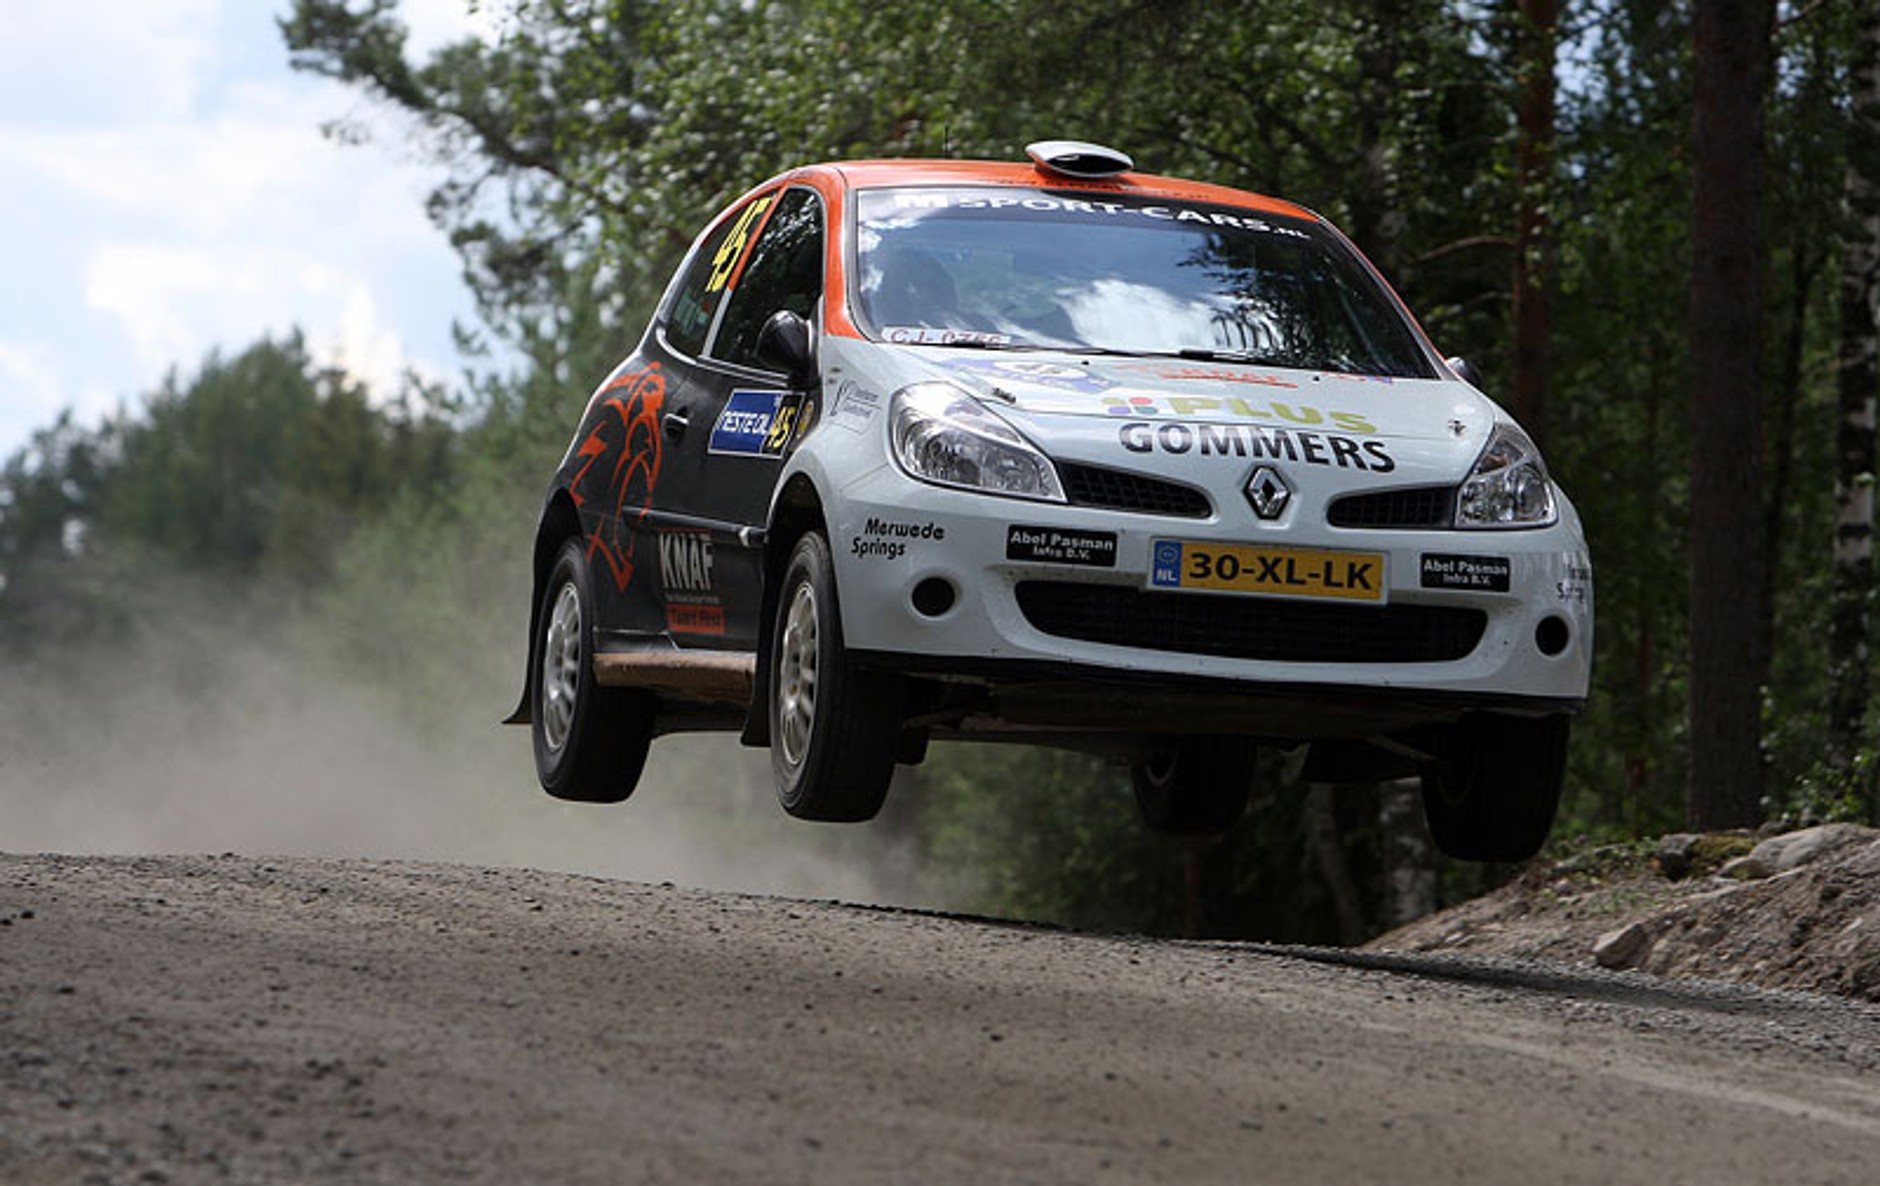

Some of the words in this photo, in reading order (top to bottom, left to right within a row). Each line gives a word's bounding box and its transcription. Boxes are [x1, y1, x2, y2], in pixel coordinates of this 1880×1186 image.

[705, 197, 771, 293] 45
[766, 406, 796, 448] 45
[1168, 397, 1377, 433] PLUS
[1119, 422, 1395, 473] GOMMERS
[865, 519, 944, 541] Merwede
[1011, 531, 1047, 546] Abel
[1051, 533, 1113, 551] Pasman
[659, 532, 713, 591] KNAF
[852, 537, 906, 560] Springs
[1156, 568, 1177, 582] NL
[1189, 552, 1373, 590] 30-XL-LK
[1424, 559, 1455, 573] Abel
[1458, 561, 1508, 576] Pasman
